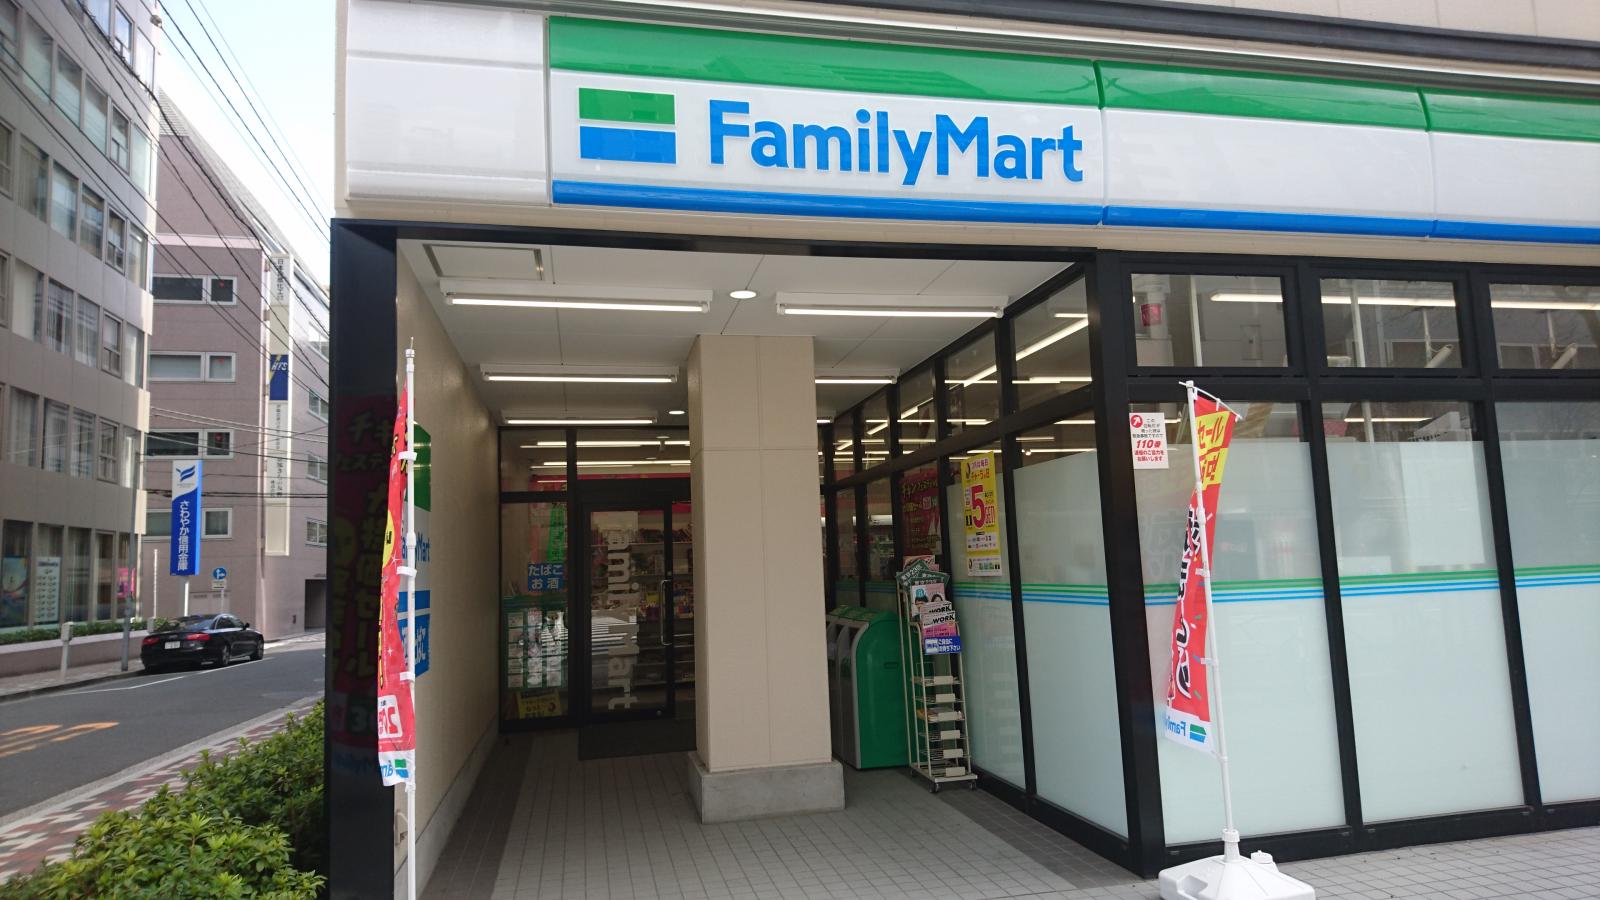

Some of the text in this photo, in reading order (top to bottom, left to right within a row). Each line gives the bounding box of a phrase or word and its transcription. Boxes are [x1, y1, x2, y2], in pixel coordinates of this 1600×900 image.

[709, 98, 1083, 185] FamilyMart
[1136, 440, 1161, 449] 110番
[971, 485, 986, 529] 5
[177, 500, 190, 571] さわやか信用金庫
[528, 564, 563, 576] たばこ
[932, 614, 955, 627] WORK
